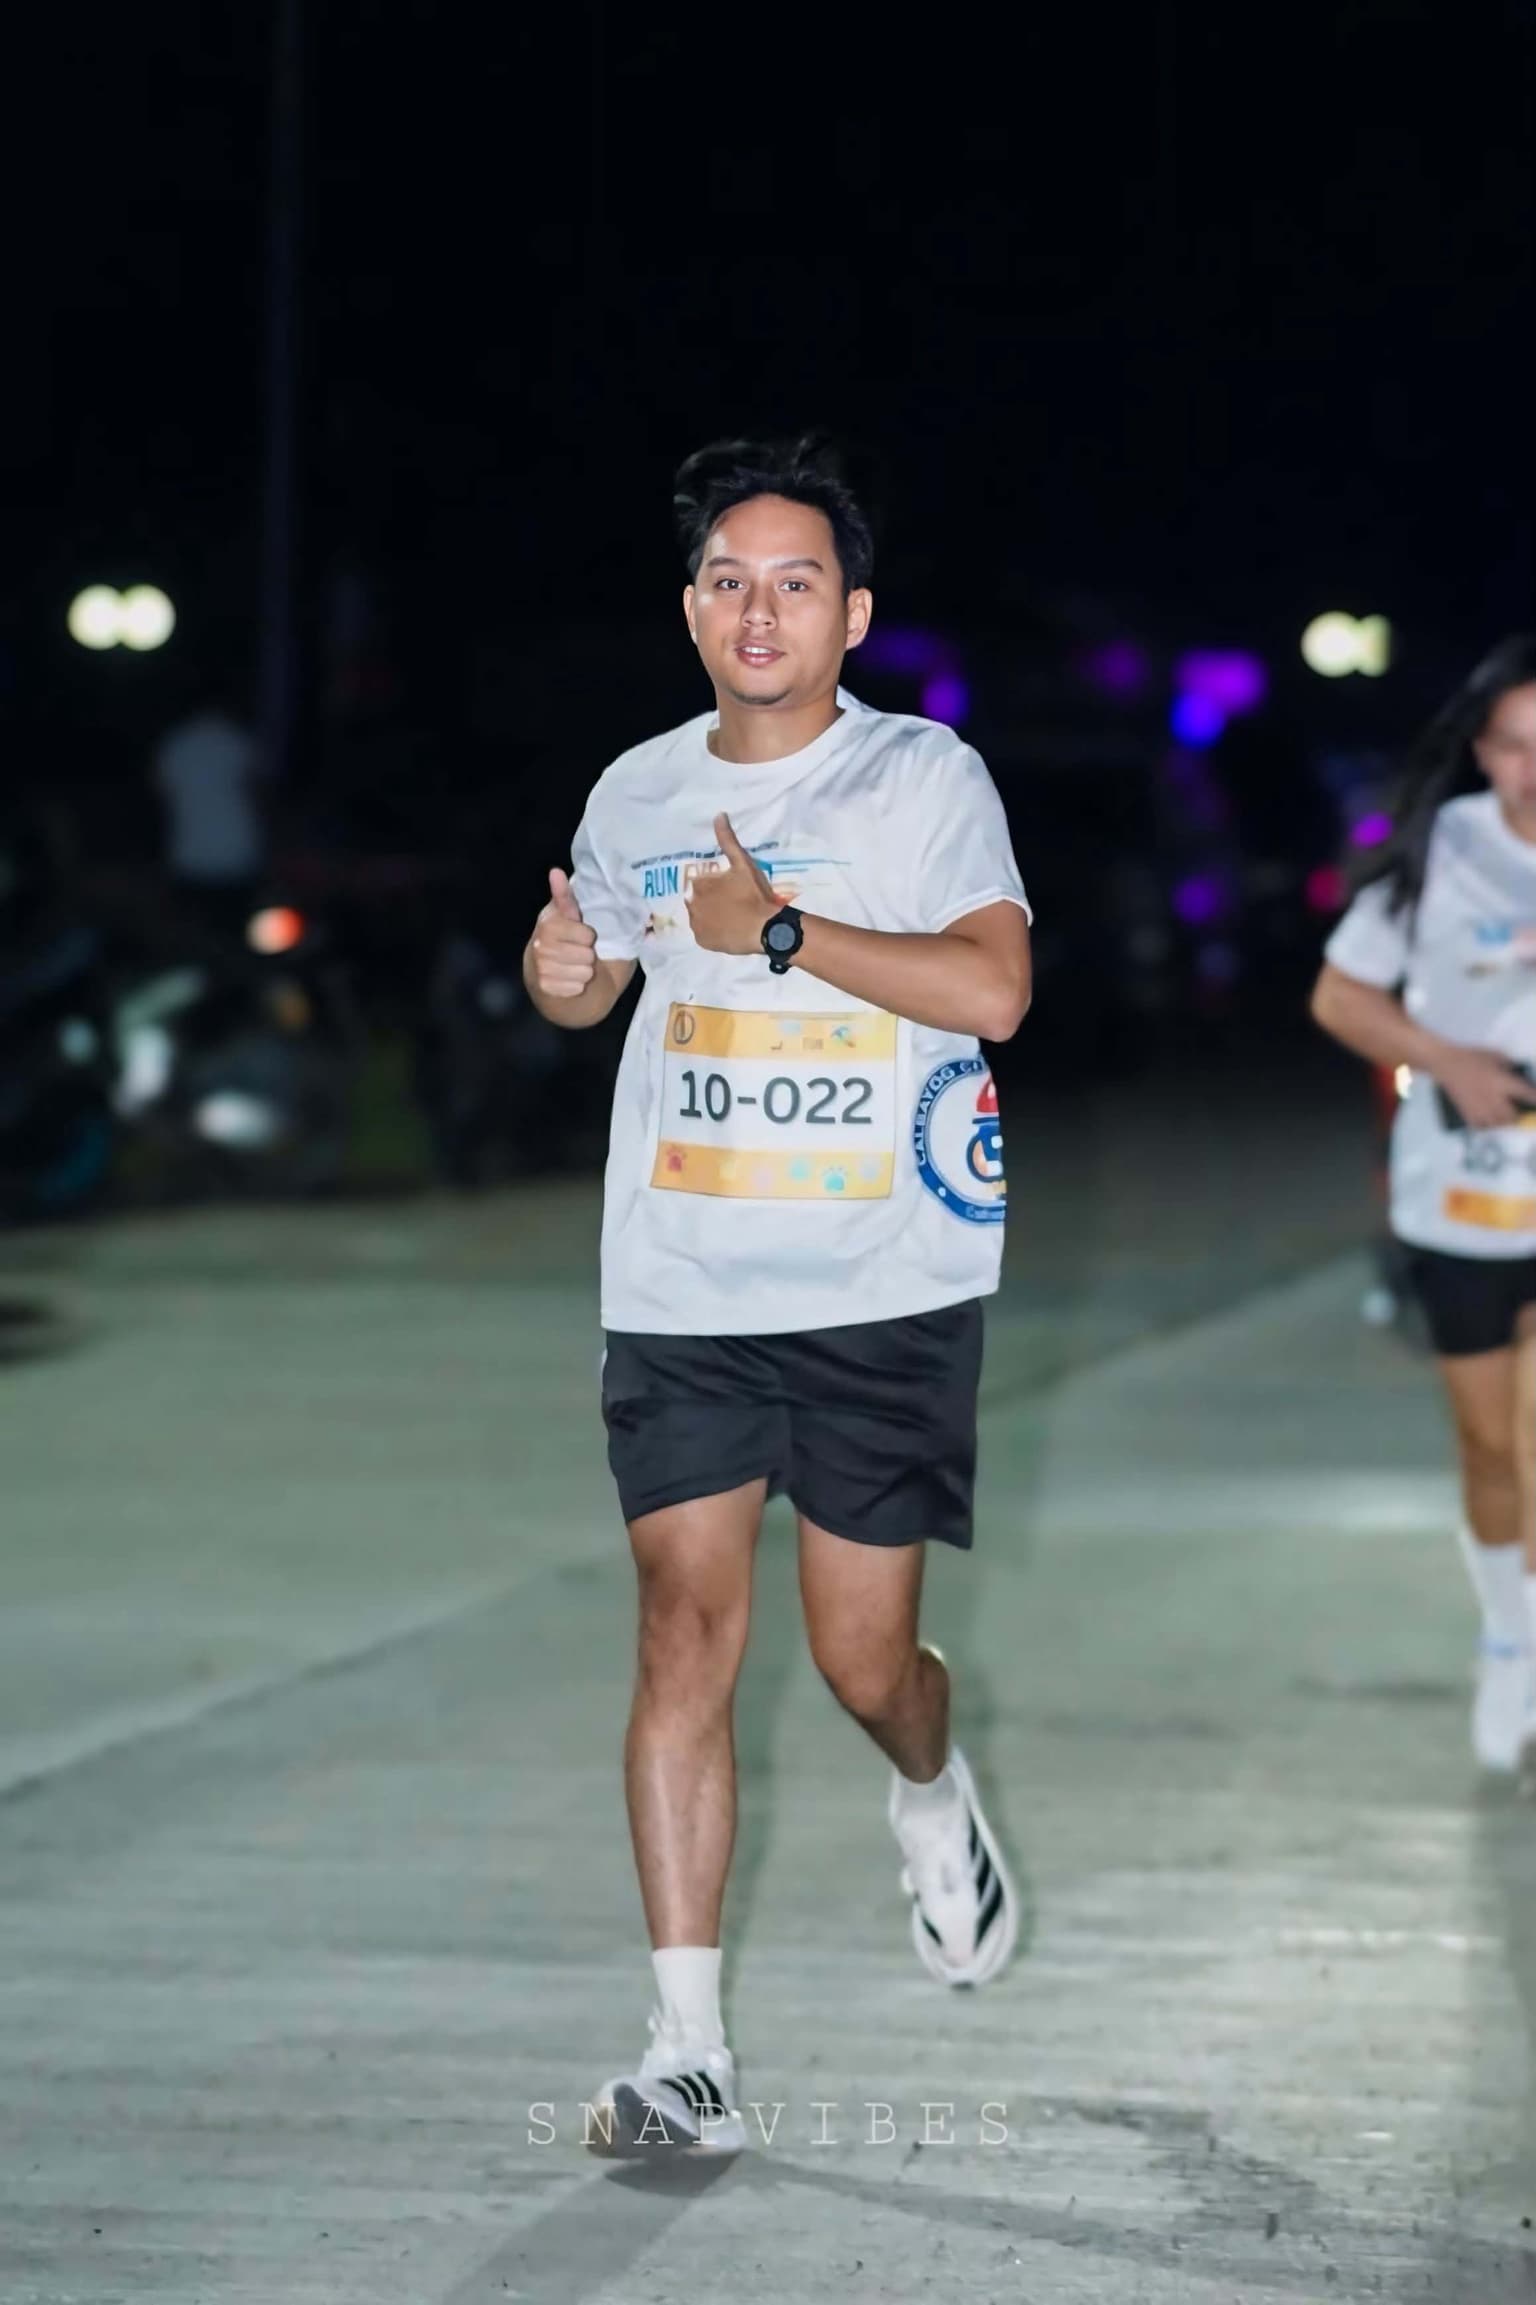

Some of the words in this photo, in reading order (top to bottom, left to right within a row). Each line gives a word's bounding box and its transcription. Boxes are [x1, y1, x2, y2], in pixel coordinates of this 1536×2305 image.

[644, 865, 679, 897] RUN
[679, 1070, 874, 1125] 10-022
[914, 1065, 956, 1167] CALBAYOG
[1461, 1135, 1536, 1175] 10-
